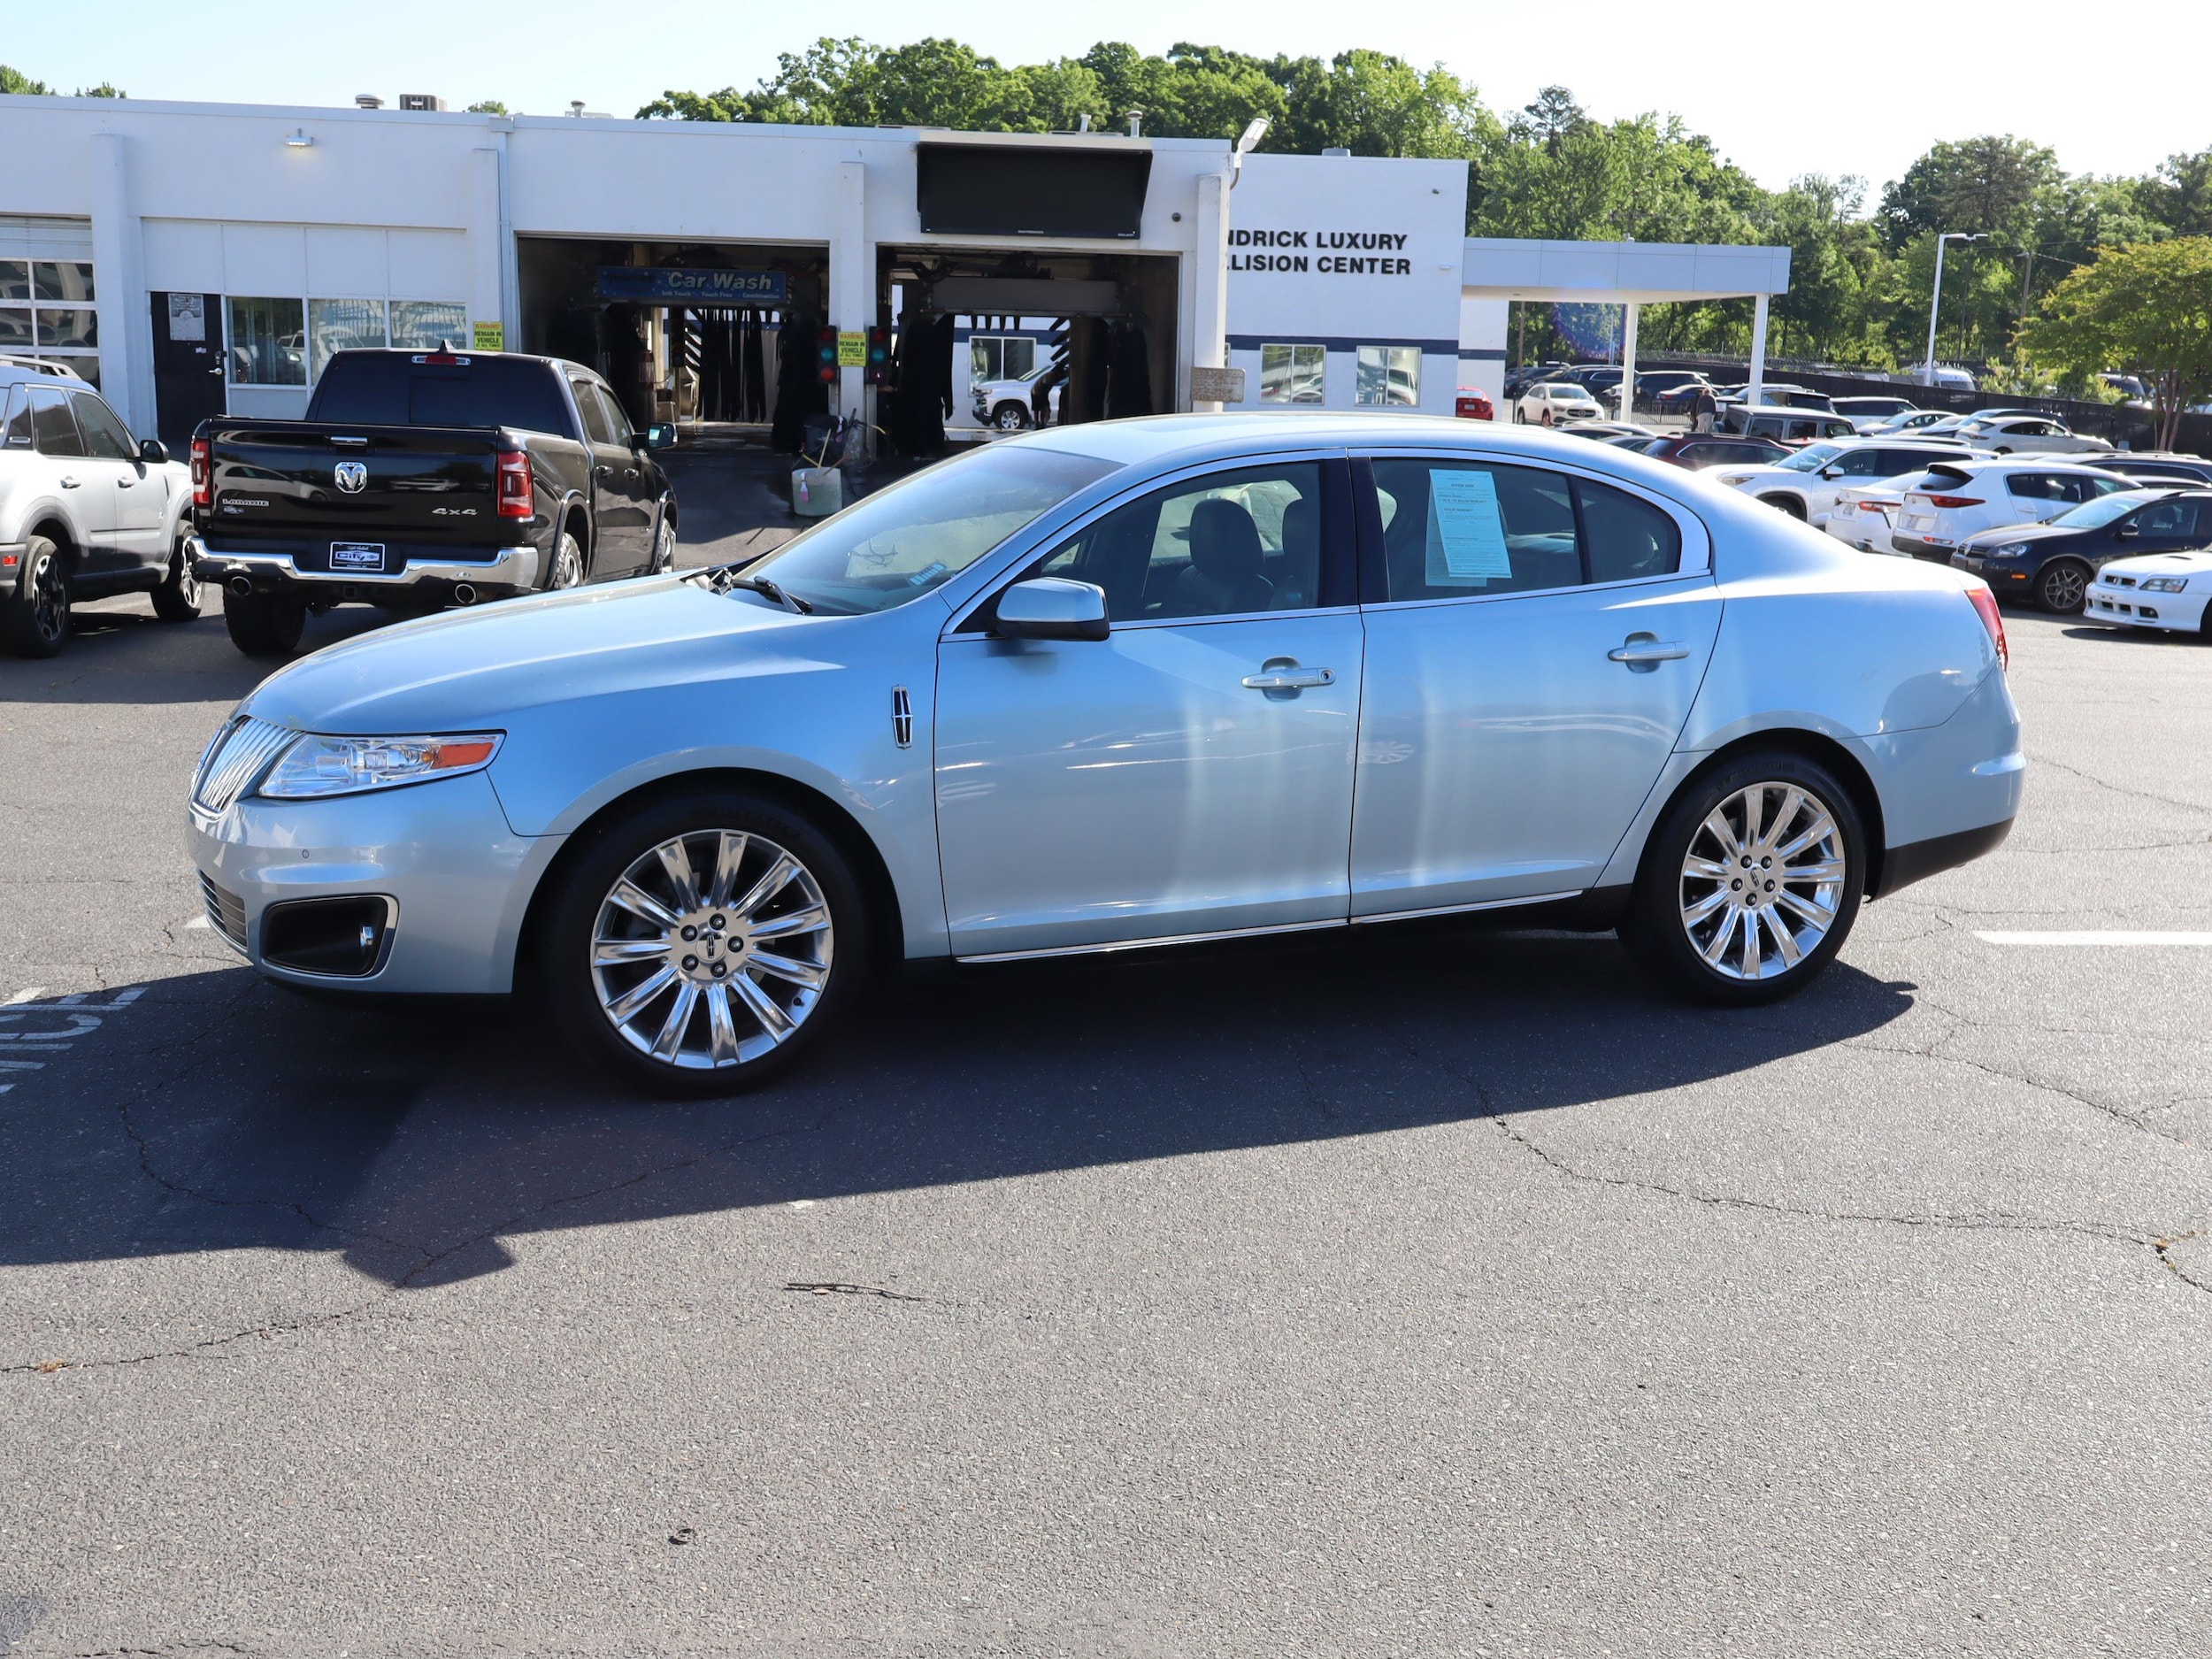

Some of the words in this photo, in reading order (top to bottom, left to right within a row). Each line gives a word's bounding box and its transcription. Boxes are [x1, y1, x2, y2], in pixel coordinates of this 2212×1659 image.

[1316, 232, 1408, 250] LUXURY
[1227, 254, 1308, 273] LISION
[1317, 257, 1410, 275] CENTER
[668, 271, 707, 288] Car
[713, 273, 772, 291] Wash
[431, 507, 479, 516] 4x4
